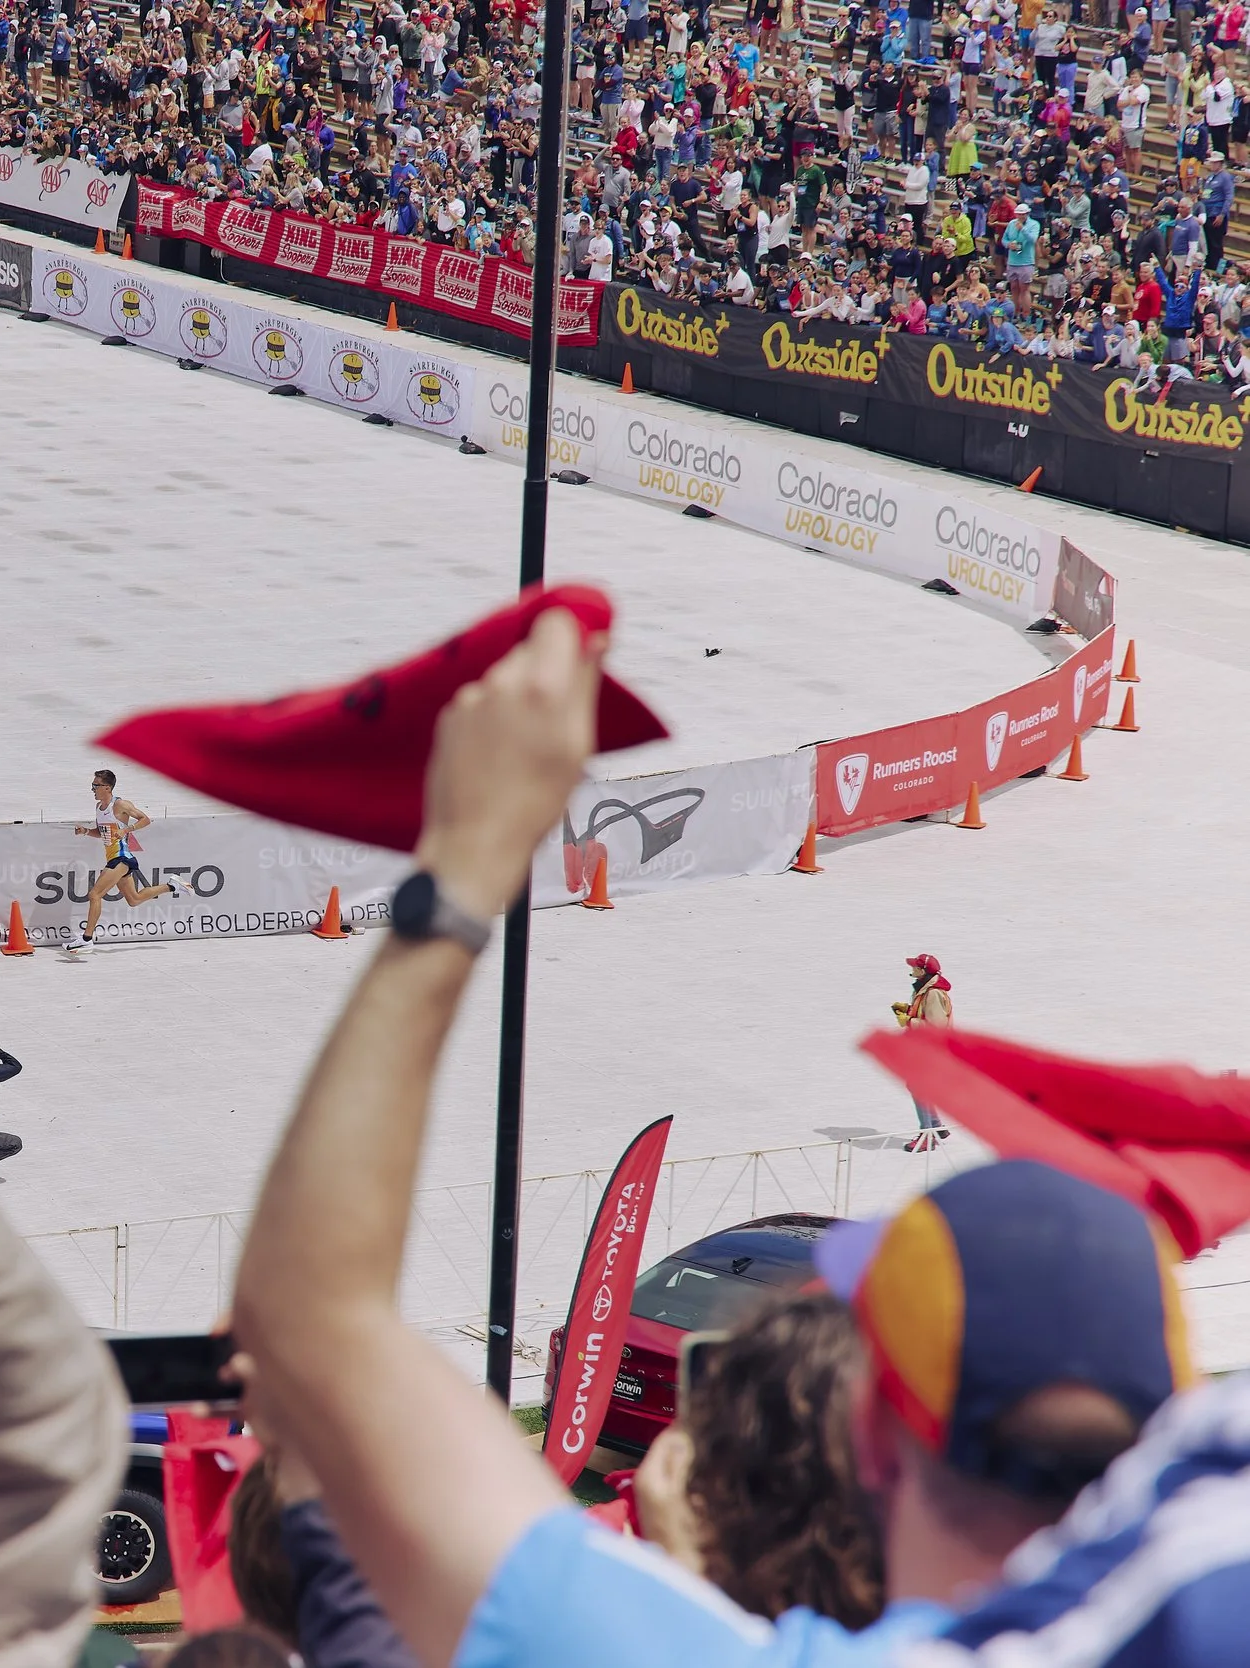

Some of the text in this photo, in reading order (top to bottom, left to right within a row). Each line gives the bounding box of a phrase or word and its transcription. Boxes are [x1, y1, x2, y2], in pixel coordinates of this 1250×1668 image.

[225, 205, 268, 234] KING
[221, 225, 262, 250] Soopers
[284, 223, 317, 248] KING
[337, 236, 370, 260] KING
[280, 243, 314, 266] Soopers
[335, 256, 368, 277] Soopers
[389, 246, 422, 270] KING
[44, 257, 88, 284] SNARFBURGER
[384, 266, 420, 289] Soopers
[442, 255, 480, 283] KING
[112, 277, 155, 303] SNARFBURGER
[437, 275, 476, 302] Soopers
[559, 290, 593, 313] ING
[181, 297, 227, 324] SNARFBURGER
[254, 318, 303, 343] SNARFBURGER
[332, 340, 380, 366] SNARFBURGER
[409, 361, 461, 389] SNARFBURGER
[488, 383, 595, 442] Colado
[502, 424, 582, 466] UROGY
[627, 420, 742, 483] Colorado
[639, 463, 726, 508] UROLOGY
[777, 461, 898, 528] Colorado
[784, 506, 880, 555] UROLOGY
[935, 505, 1041, 578] Colorado
[948, 552, 1026, 606] UROLOGY
[1008, 712, 1040, 737] Runners
[1021, 730, 1048, 747] COLORADO
[873, 746, 958, 780] Runners Roost
[893, 775, 935, 792] COLORADO
[258, 846, 370, 869] SUUNTO
[34, 864, 225, 905] SUNTO
[174, 915, 194, 935] of
[200, 902, 391, 933] BOLDERBODER
[562, 1182, 636, 1454] Corwin TOYOTA
[614, 1379, 642, 1395] orwin
